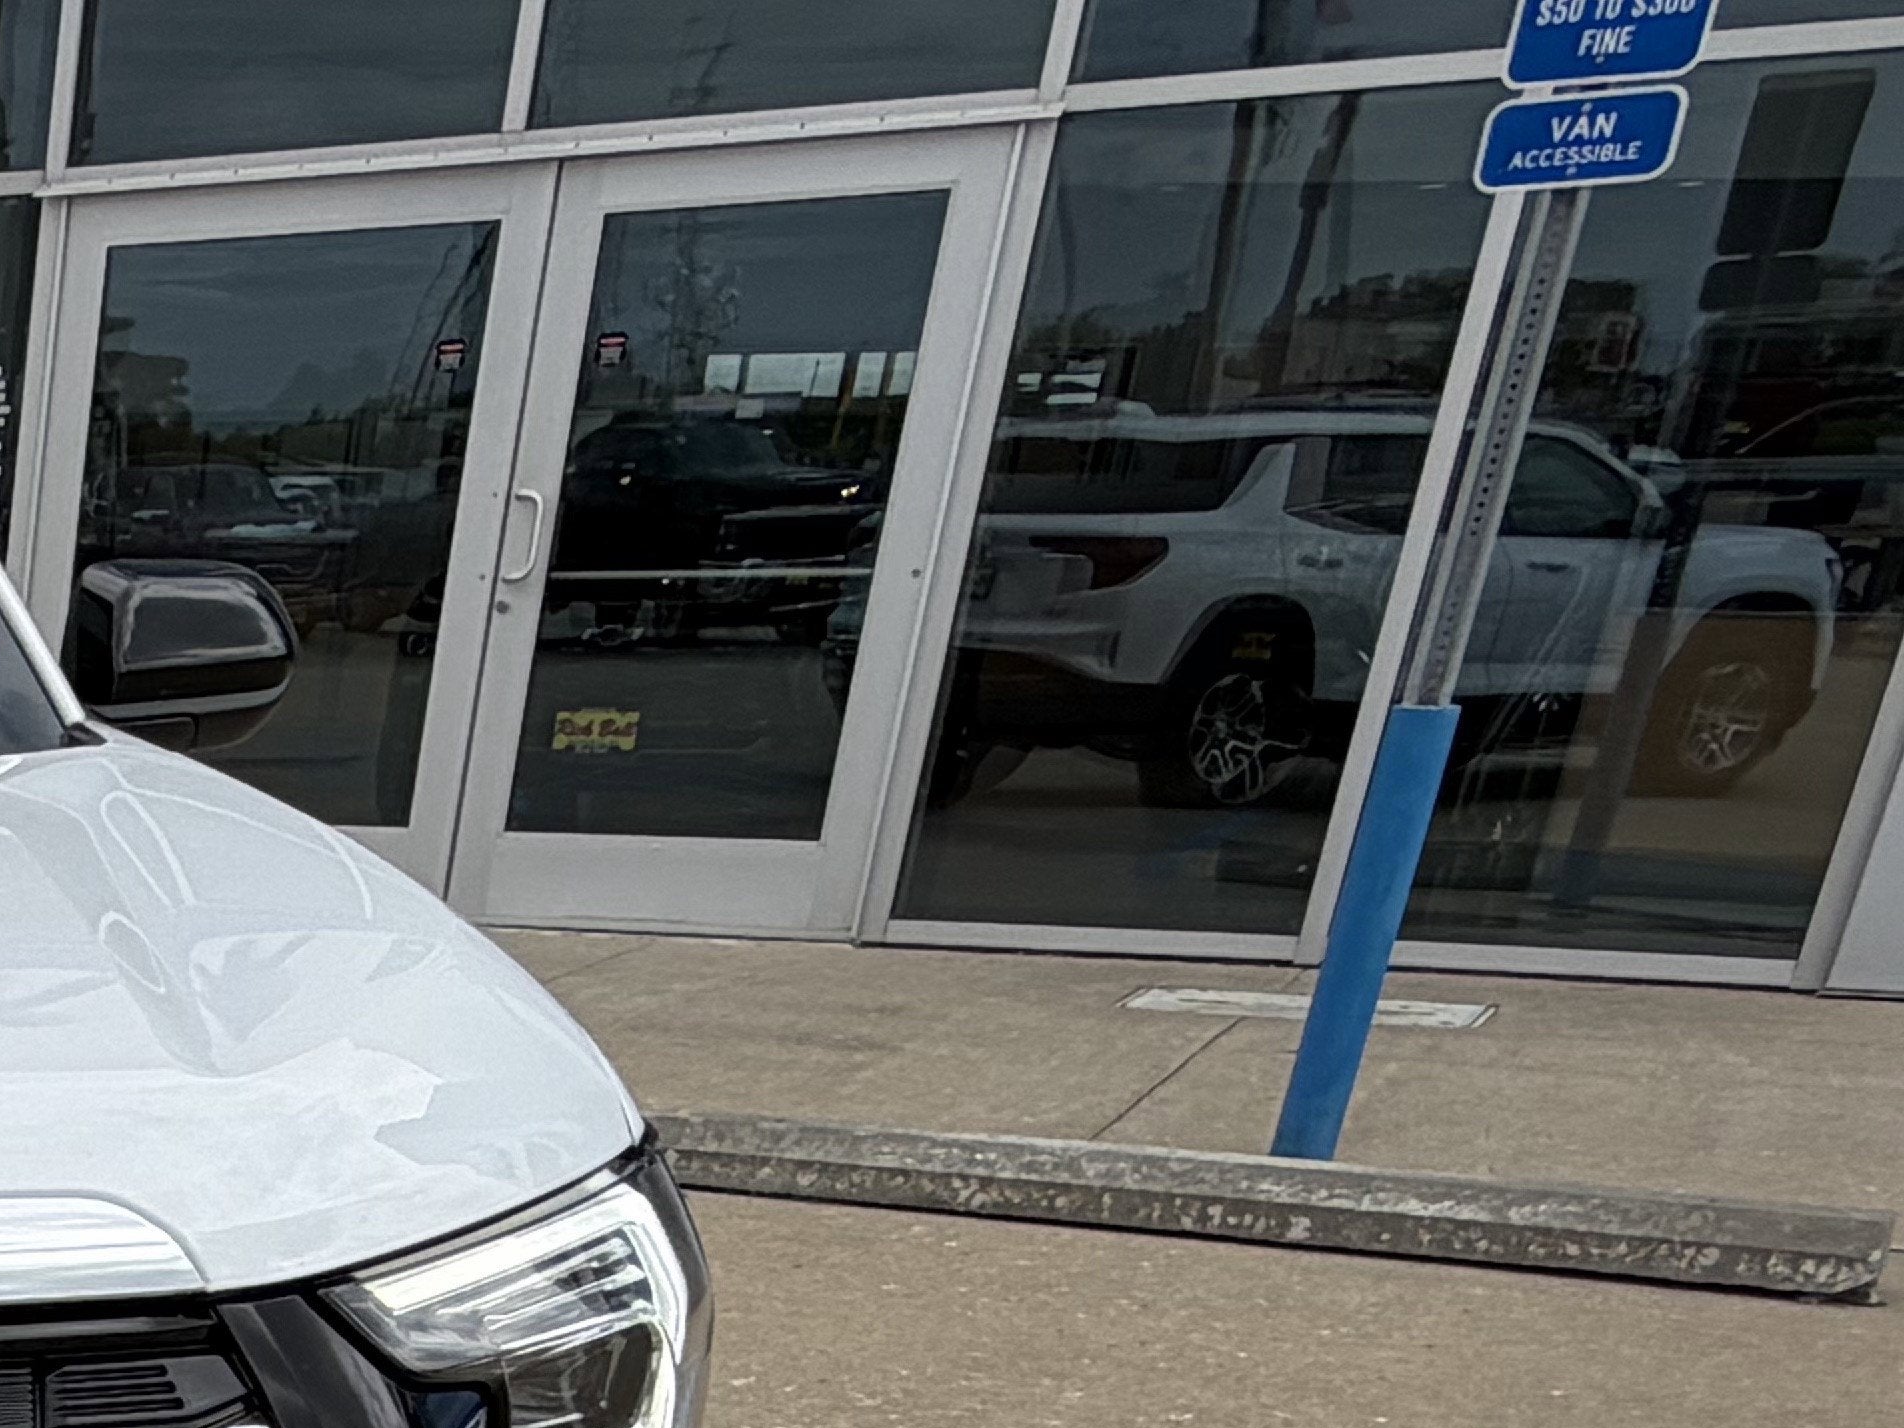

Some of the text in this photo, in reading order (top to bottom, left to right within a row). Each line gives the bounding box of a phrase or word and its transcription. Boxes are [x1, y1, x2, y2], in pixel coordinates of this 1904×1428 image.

[1536, 0, 1584, 26] $50
[1577, 25, 1636, 57] FINE
[1551, 112, 1617, 143] VAN
[1507, 141, 1641, 171] ACCESSIBLE
